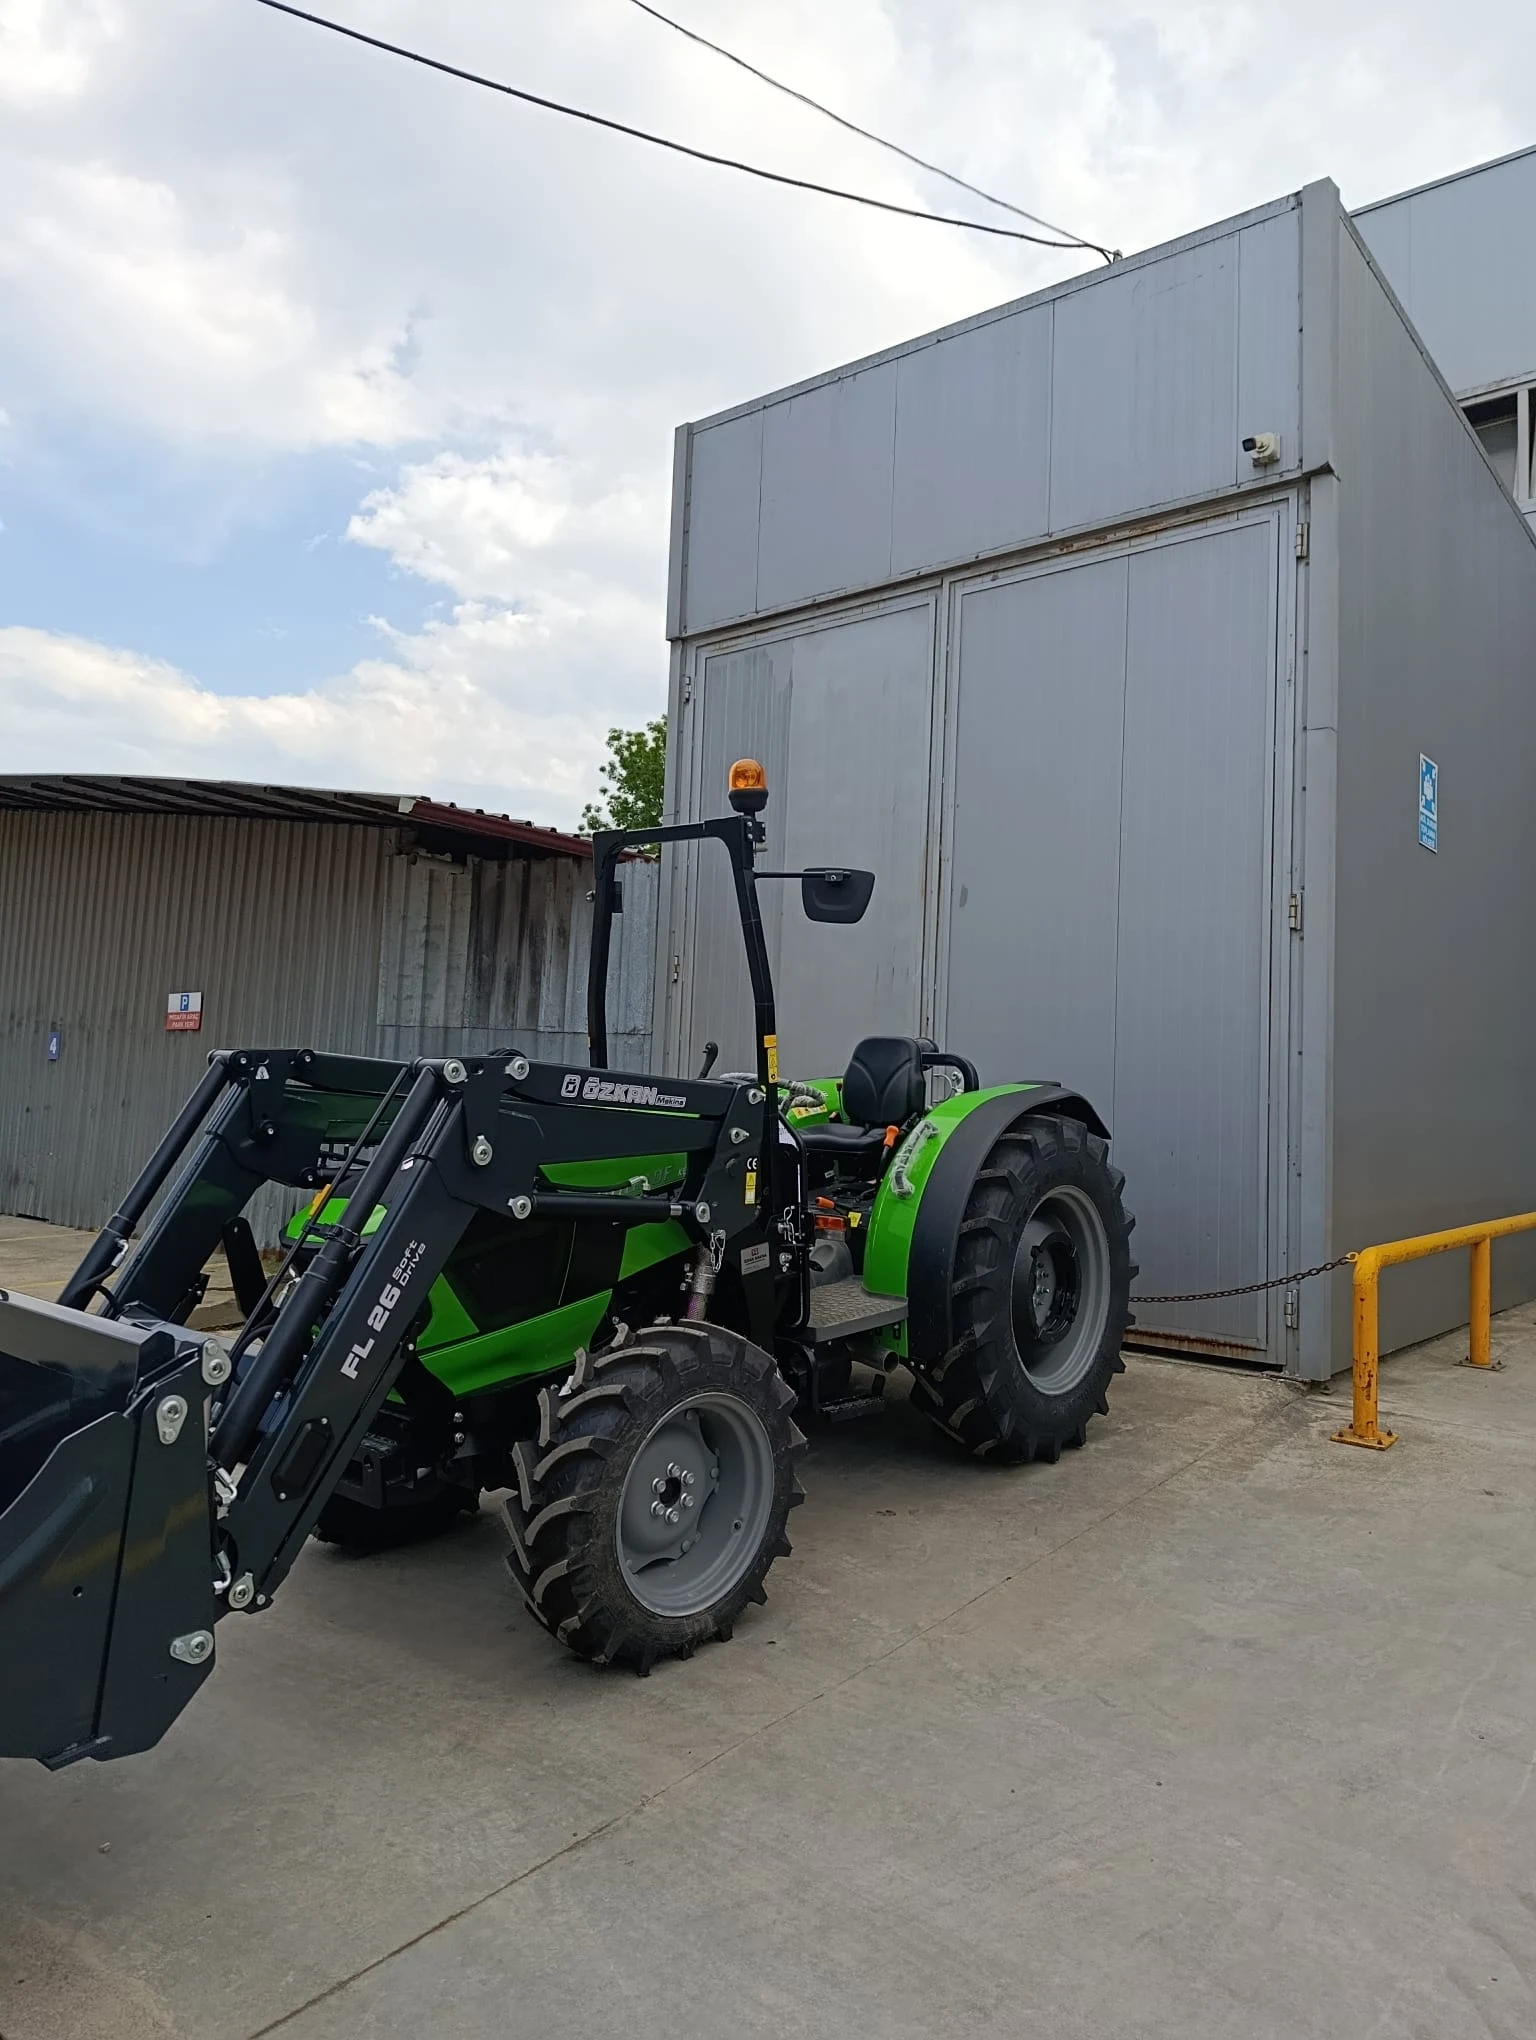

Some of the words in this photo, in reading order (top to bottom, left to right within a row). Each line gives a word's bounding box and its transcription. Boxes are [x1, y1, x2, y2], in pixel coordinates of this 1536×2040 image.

[50, 1037, 57, 1054] 4
[582, 1076, 657, 1105] ÖZKAN
[746, 1157, 758, 1170] CE
[392, 1240, 417, 1281] Soft
[398, 1243, 426, 1287] Drive
[340, 1338, 375, 1380] FL
[367, 1283, 401, 1332] 26
